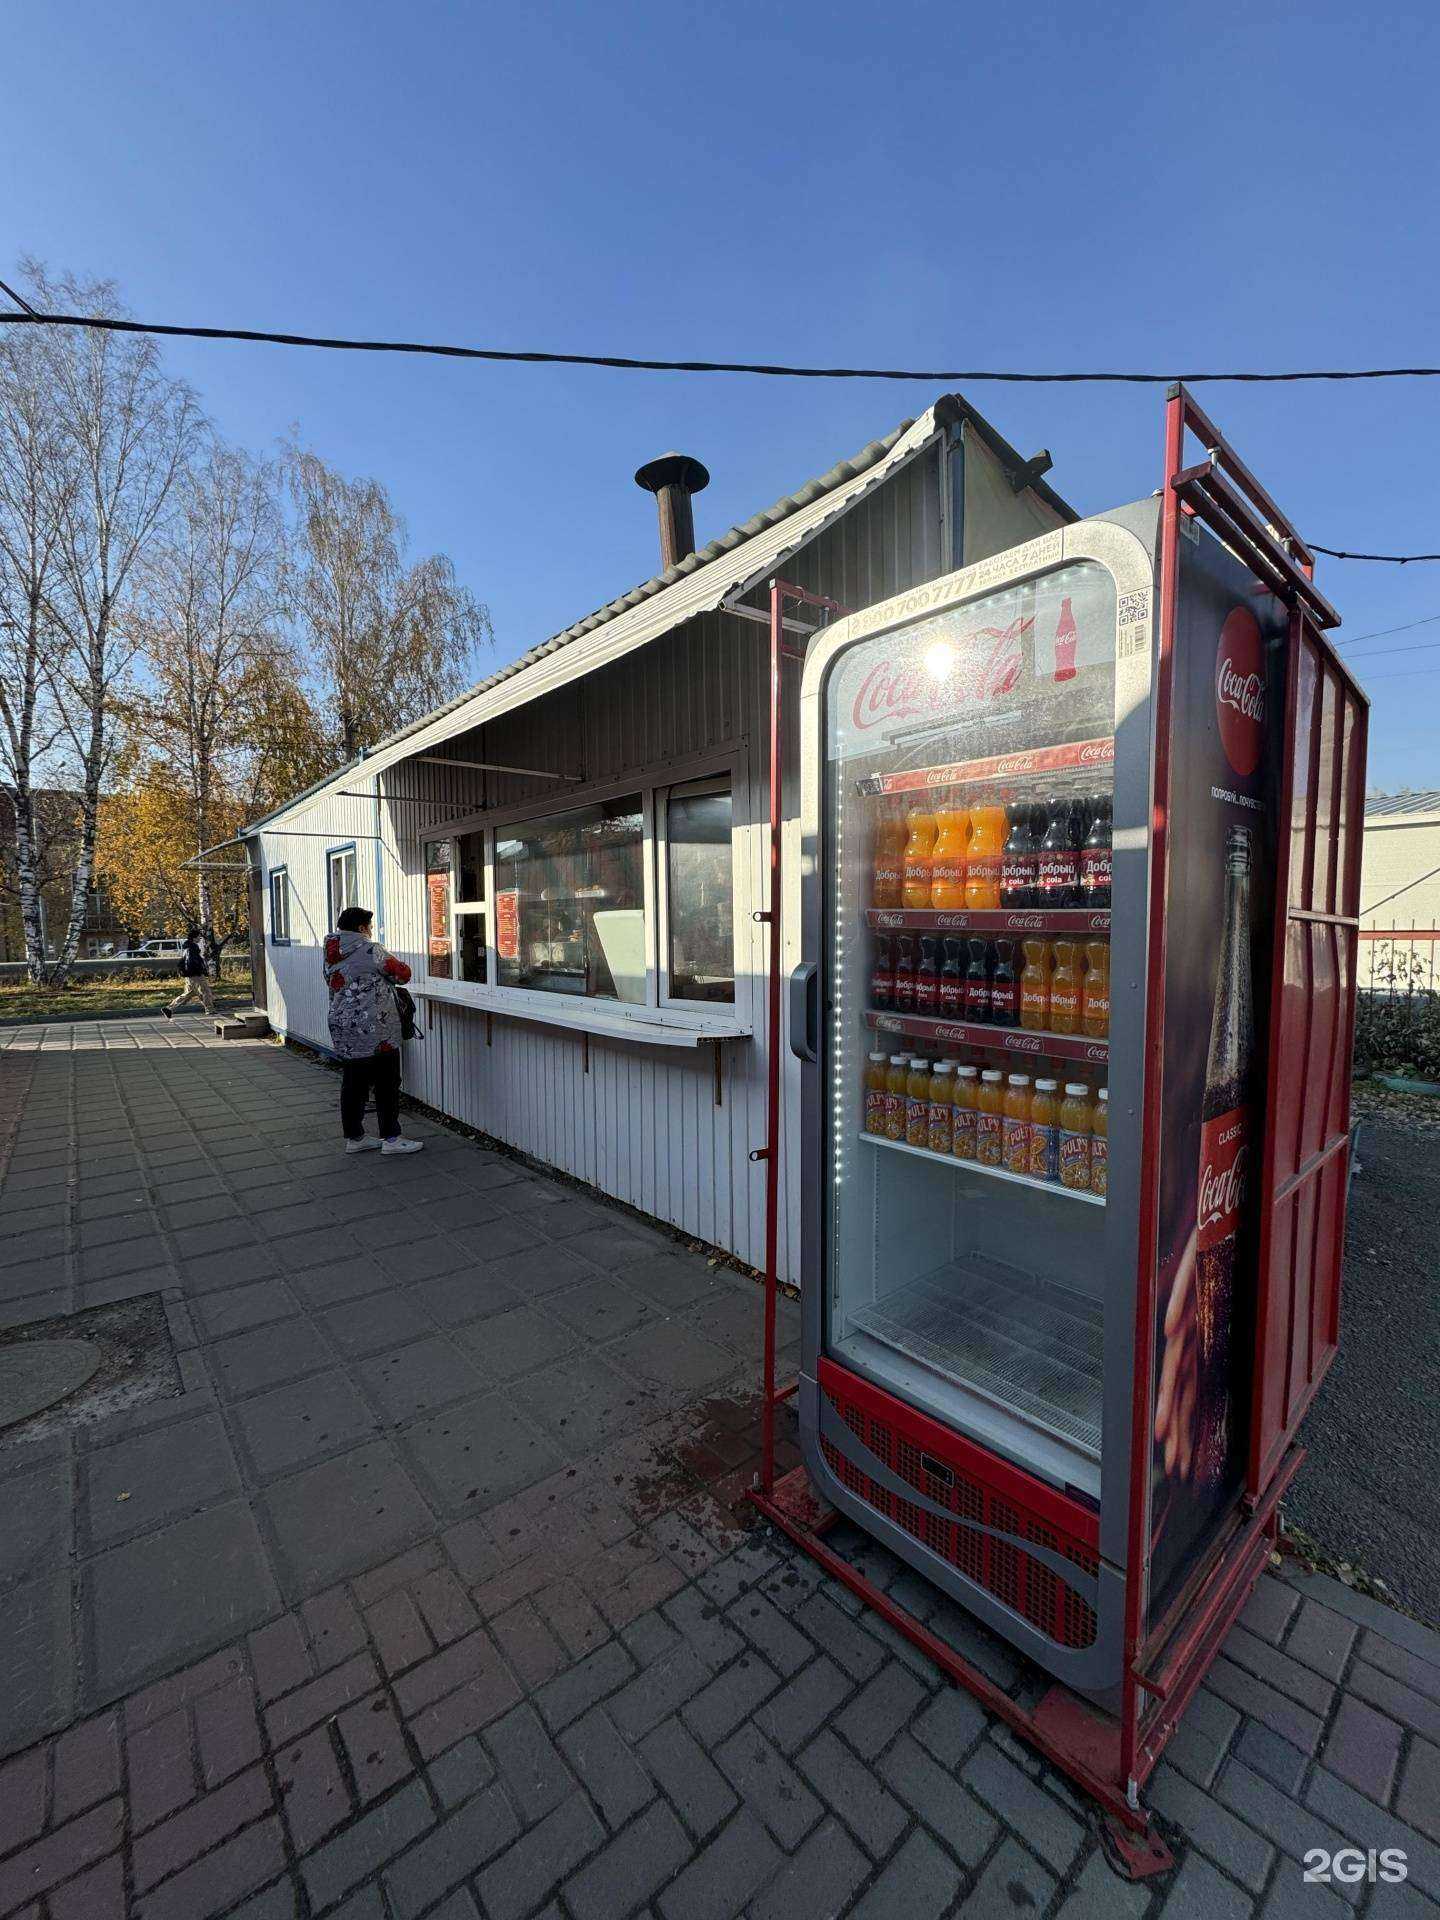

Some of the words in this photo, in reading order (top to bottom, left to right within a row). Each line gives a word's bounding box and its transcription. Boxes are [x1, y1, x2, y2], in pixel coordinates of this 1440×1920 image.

[992, 555, 1019, 575] ЧАСА
[931, 569, 977, 604] 7777
[1046, 876, 1063, 884] cola
[1062, 1137, 1089, 1158] PULPY
[1197, 1145, 1247, 1231] Coca-Col
